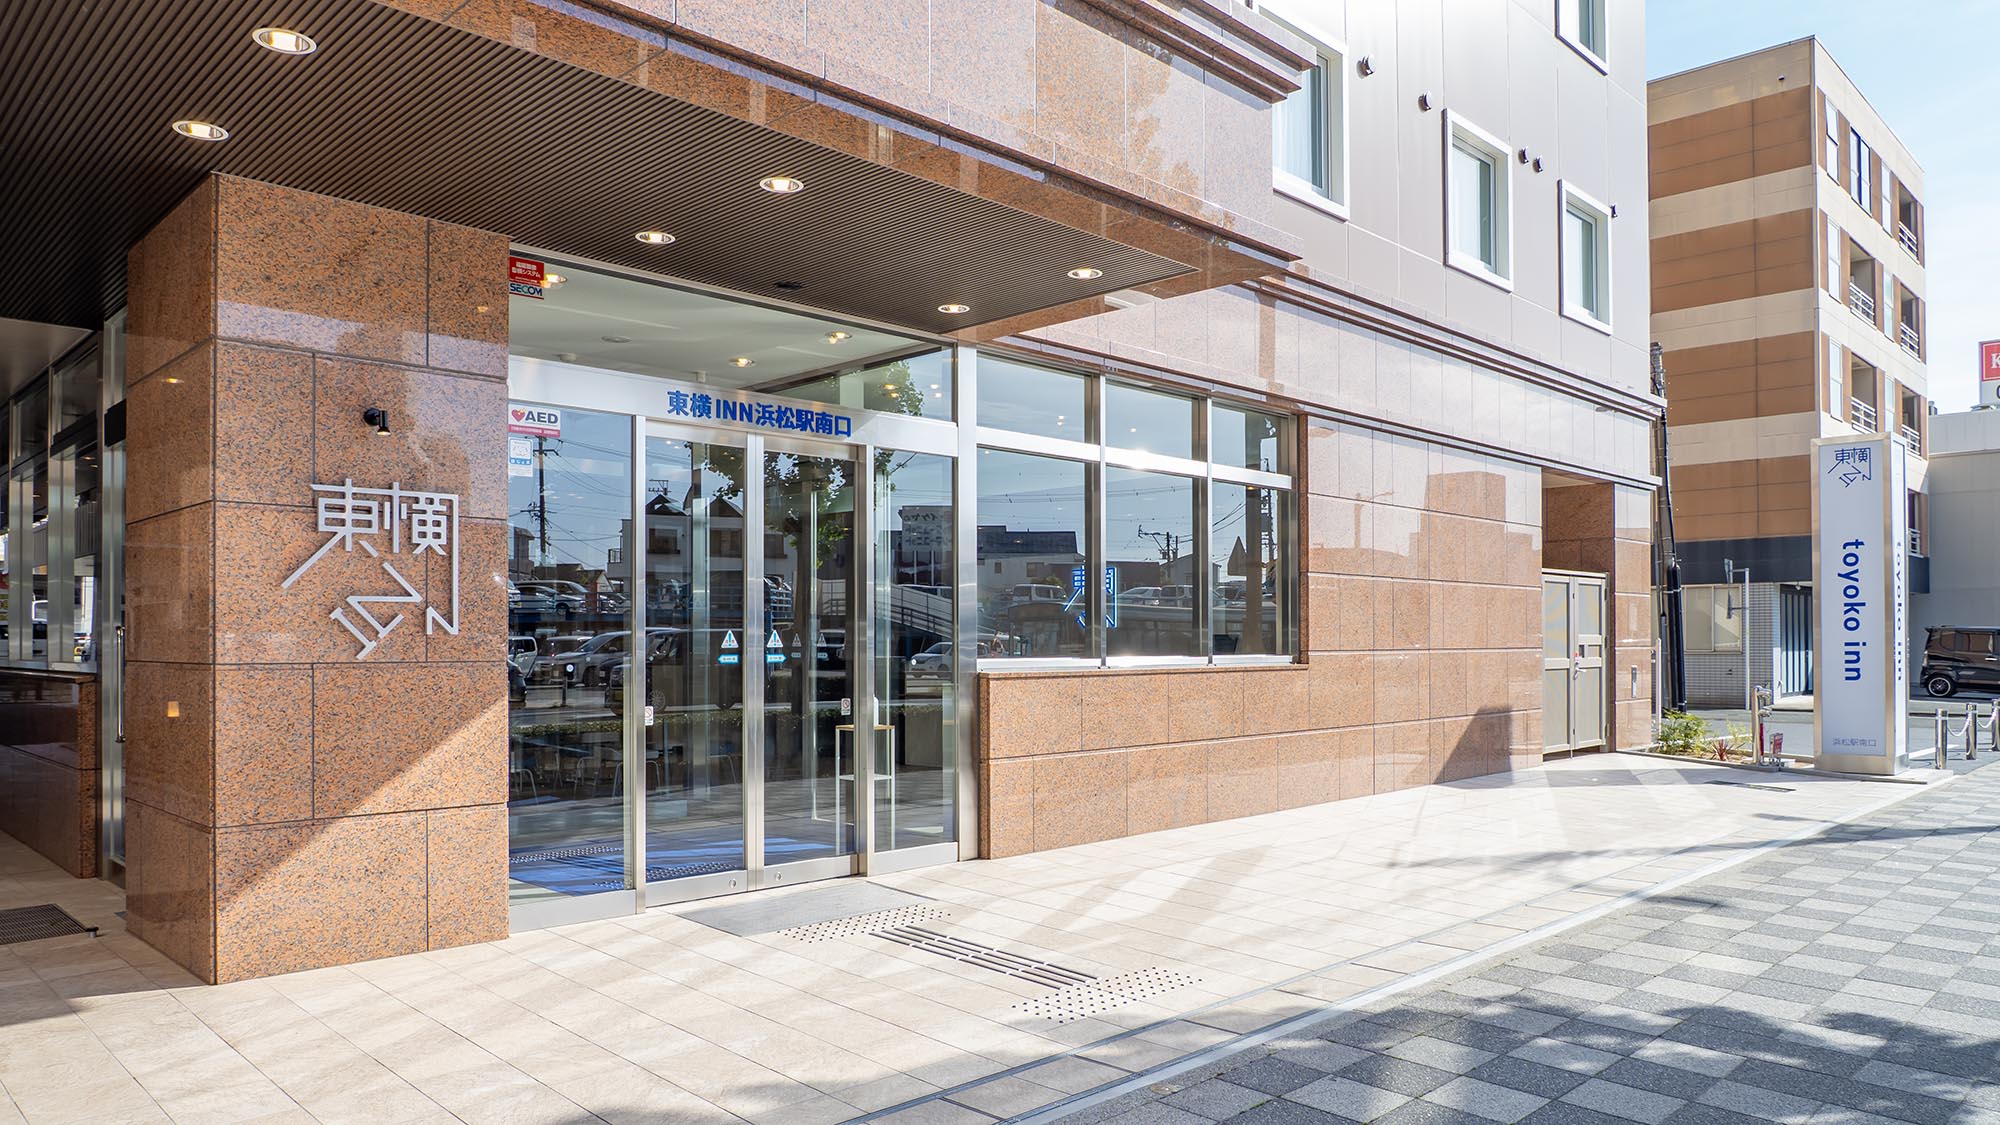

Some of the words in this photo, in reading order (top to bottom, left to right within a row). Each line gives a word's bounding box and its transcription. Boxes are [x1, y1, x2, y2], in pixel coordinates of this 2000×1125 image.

[510, 283, 542, 296] SECOM
[525, 410, 559, 424] AED
[667, 390, 852, 437] 東横INN浜松駅南口
[1837, 539, 1866, 631] toyoko
[1844, 642, 1867, 681] inn
[1832, 738, 1877, 747] 浜松駅南口
